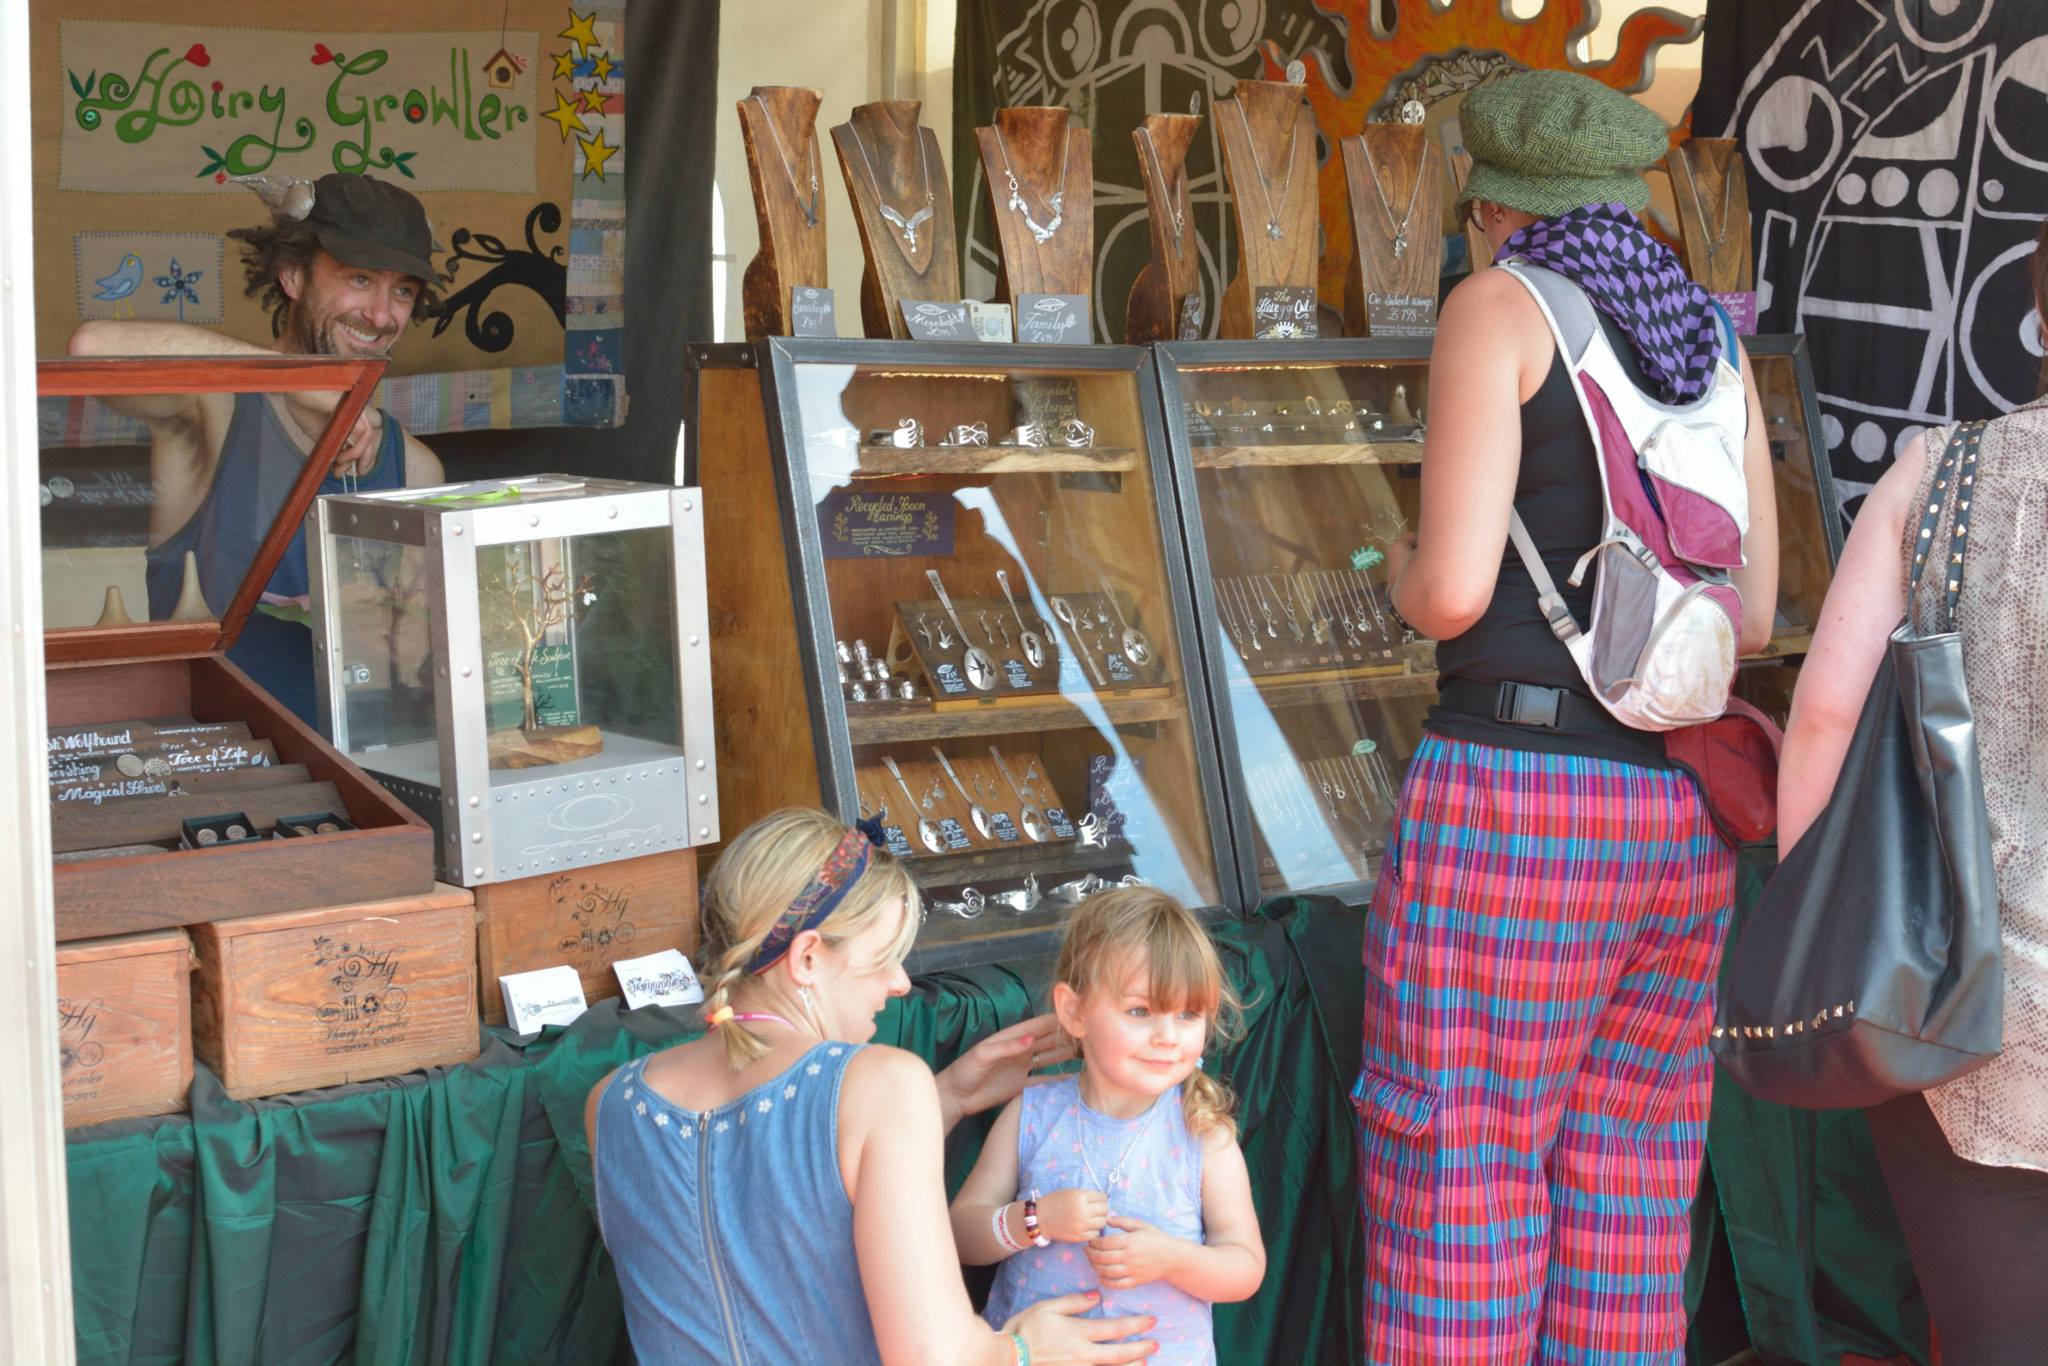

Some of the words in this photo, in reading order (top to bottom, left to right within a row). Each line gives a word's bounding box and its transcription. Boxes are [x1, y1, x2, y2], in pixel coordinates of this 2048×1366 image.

[76, 47, 316, 175] Hairy
[326, 47, 528, 175] Growler
[1023, 311, 1064, 341] Family
[844, 495, 895, 520] Recycled
[894, 496, 927, 514] Spoon
[59, 729, 132, 755] Wolfhound
[206, 748, 221, 768] of
[220, 746, 249, 765] Life
[58, 781, 124, 805] Magical
